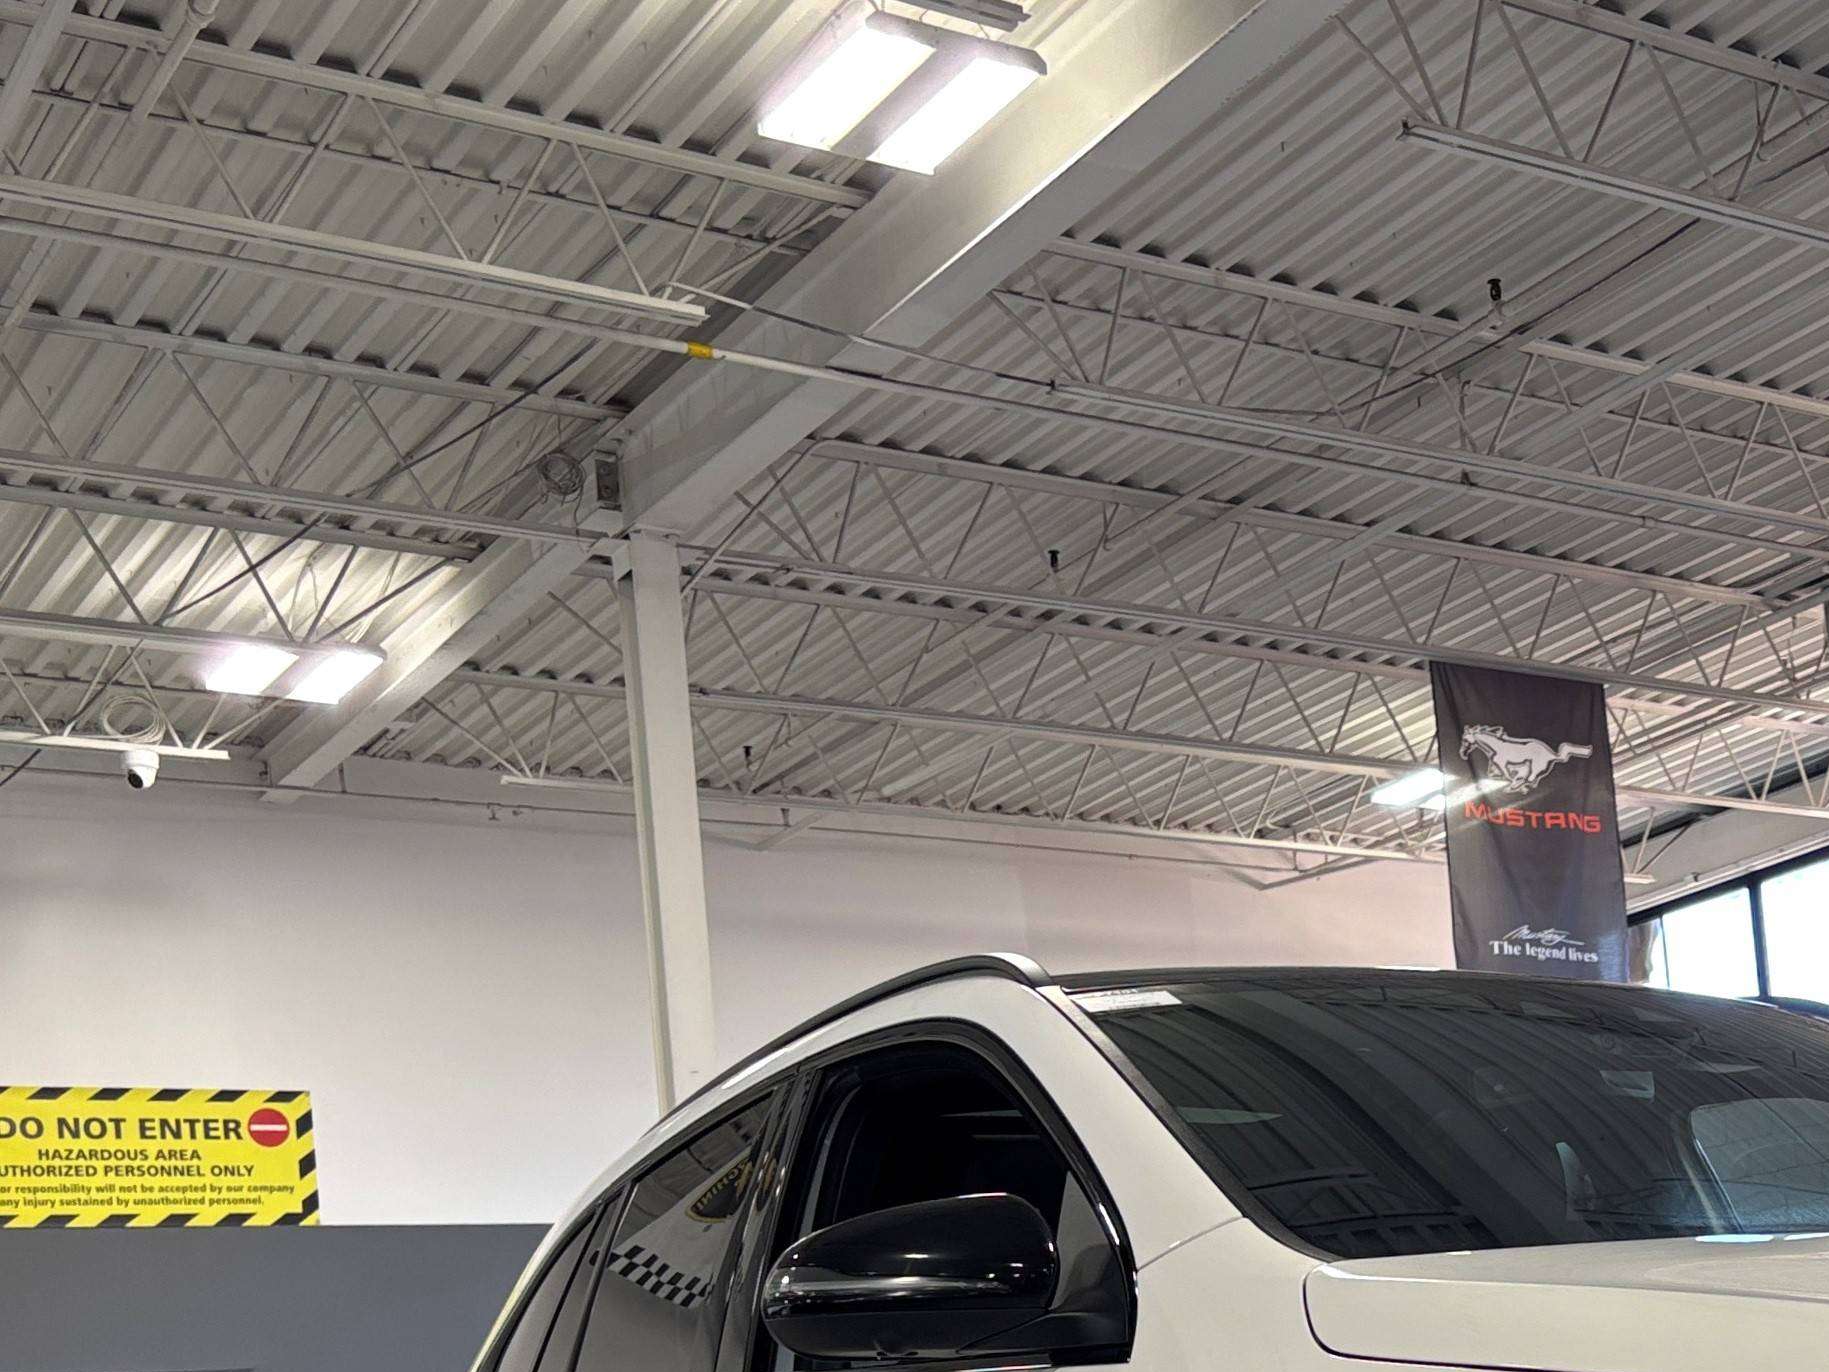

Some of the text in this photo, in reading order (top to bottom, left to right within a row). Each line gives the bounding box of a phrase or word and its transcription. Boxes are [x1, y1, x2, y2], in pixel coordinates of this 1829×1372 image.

[1464, 800, 1602, 833] MUSTANG
[1489, 940, 1599, 963] The legend lives
[0, 1116, 243, 1140] DO NOT ENTER
[38, 1148, 202, 1161] HAZARDOUS AREA
[0, 1164, 254, 1178] UTHORIZED PERSONNEL ONLY
[15, 1183, 92, 1195] responsibility
[95, 1183, 115, 1193] will
[119, 1184, 137, 1193] not
[141, 1184, 155, 1193] be
[158, 1184, 206, 1194] accepted
[210, 1184, 222, 1194] by
[226, 1185, 244, 1193] our
[247, 1184, 294, 1195] company
[23, 1196, 57, 1208] injury
[60, 1196, 113, 1206] sustained
[116, 1197, 130, 1208] by
[133, 1195, 206, 1206] unauthorized
